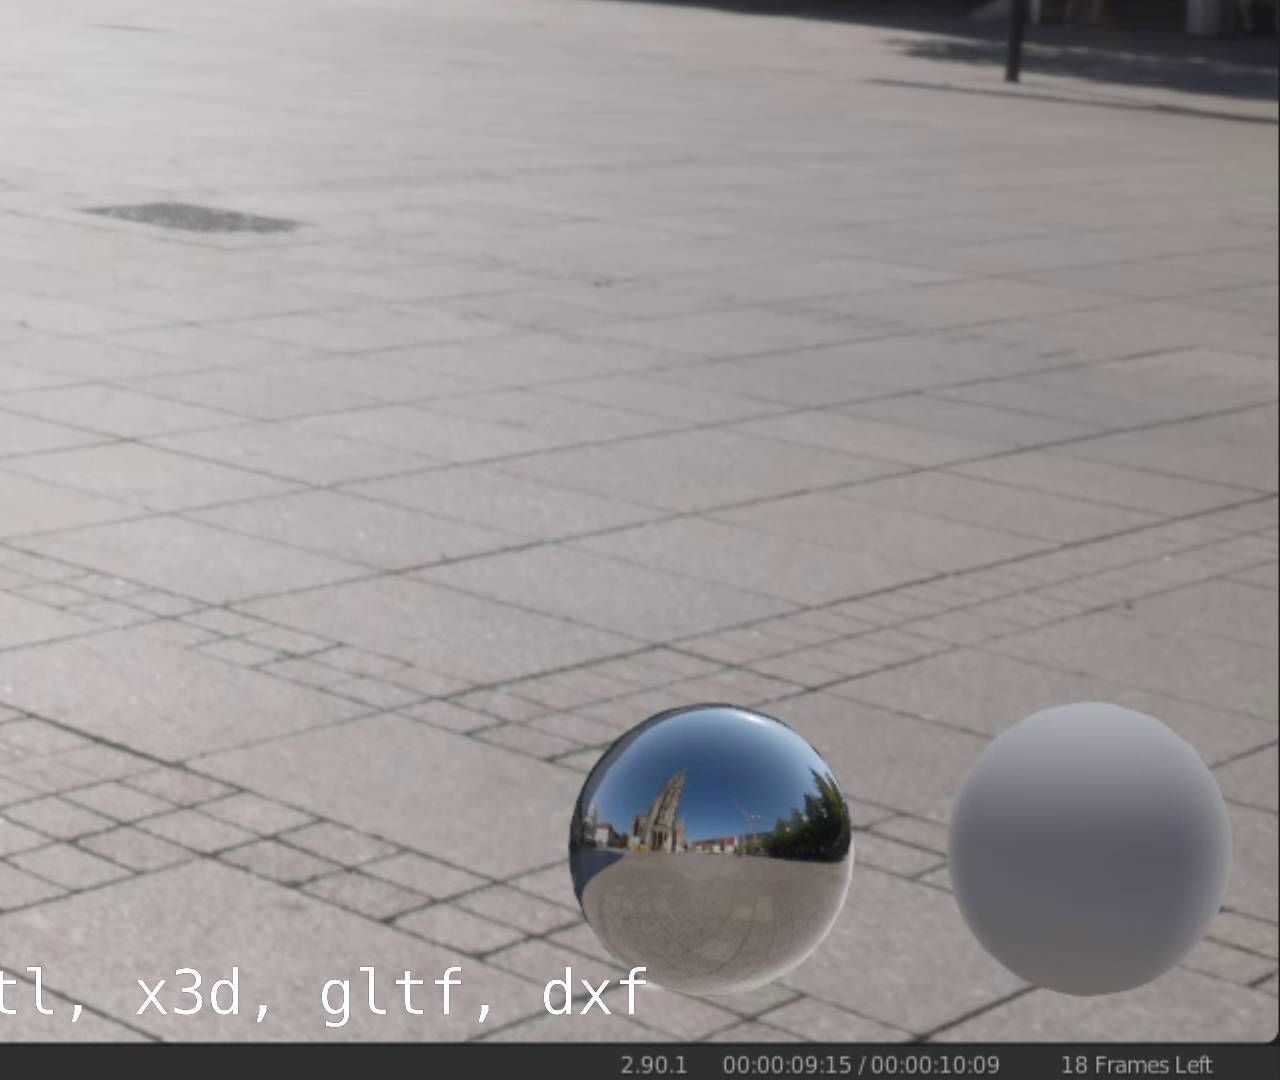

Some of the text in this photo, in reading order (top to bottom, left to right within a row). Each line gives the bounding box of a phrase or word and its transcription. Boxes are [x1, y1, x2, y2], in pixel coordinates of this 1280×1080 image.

[621, 1055, 688, 1074] 2.90.1
[723, 1055, 851, 1074] 00:00:09:15
[871, 1055, 1000, 1074] 00:00:10:09
[1062, 1055, 1213, 1074] 18 Frames Left
